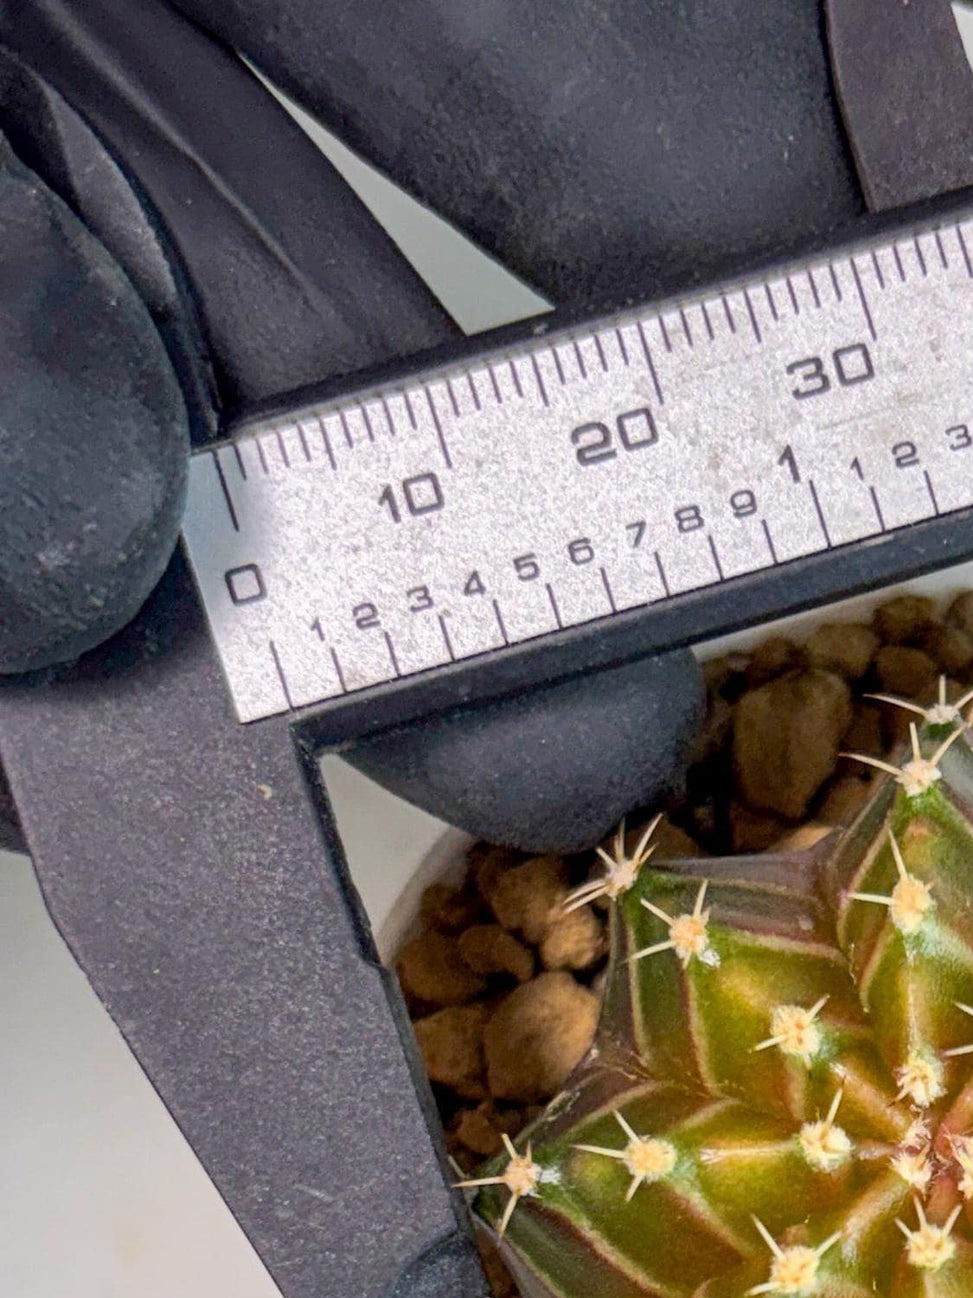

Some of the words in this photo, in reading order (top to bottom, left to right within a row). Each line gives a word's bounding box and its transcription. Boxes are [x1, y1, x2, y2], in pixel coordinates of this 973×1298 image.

[224, 563, 267, 607] 0
[378, 472, 445, 524] 10
[570, 407, 659, 467] 20
[786, 342, 875, 401] 30
[310, 617, 325, 642] 1
[352, 602, 381, 630] 2
[406, 585, 435, 612] 3
[464, 571, 486, 596] 4
[513, 553, 540, 581] 5
[567, 537, 595, 565] 6
[625, 520, 647, 548] 7
[674, 505, 705, 534] 8
[730, 489, 758, 519] 9
[777, 444, 801, 483] 1
[850, 457, 864, 481] 1
[891, 441, 919, 469] 2
[945, 424, 973, 451] 3
